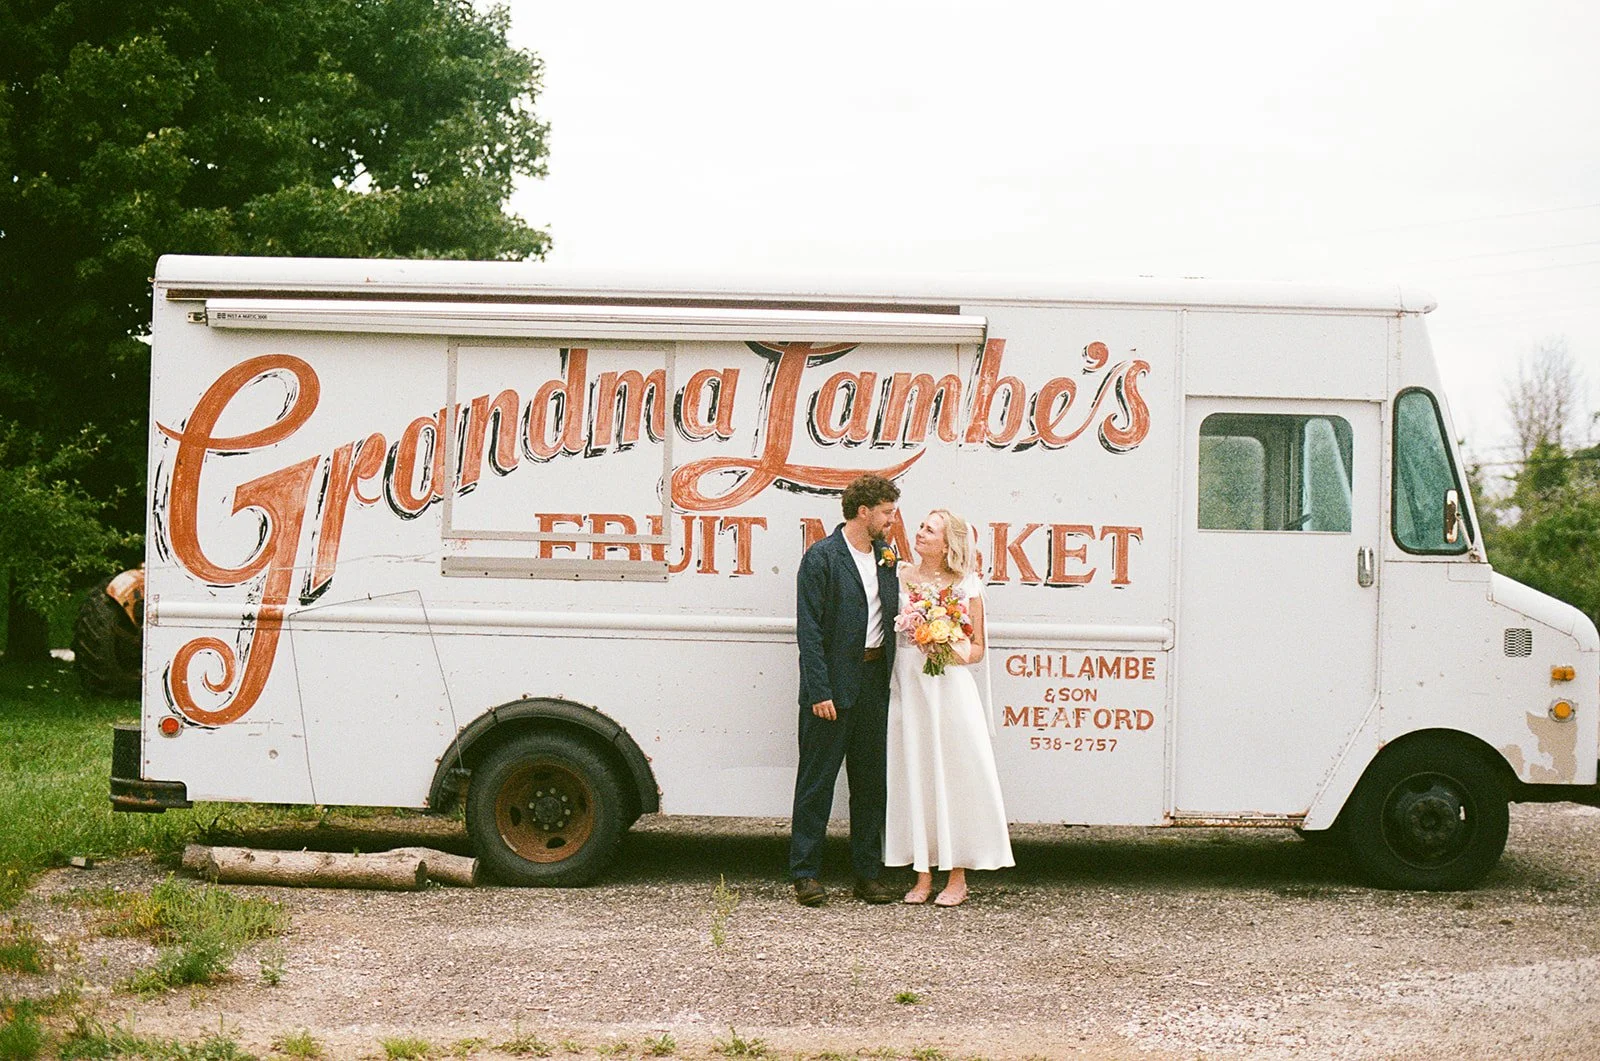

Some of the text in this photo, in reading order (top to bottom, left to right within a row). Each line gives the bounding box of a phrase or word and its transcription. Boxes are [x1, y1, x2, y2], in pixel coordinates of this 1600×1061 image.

[153, 338, 1152, 728] Grandma Lambe's
[533, 513, 768, 577] FRUIT
[1003, 705, 1154, 731] MEAFORD
[1030, 737, 1118, 752] 538-2757
